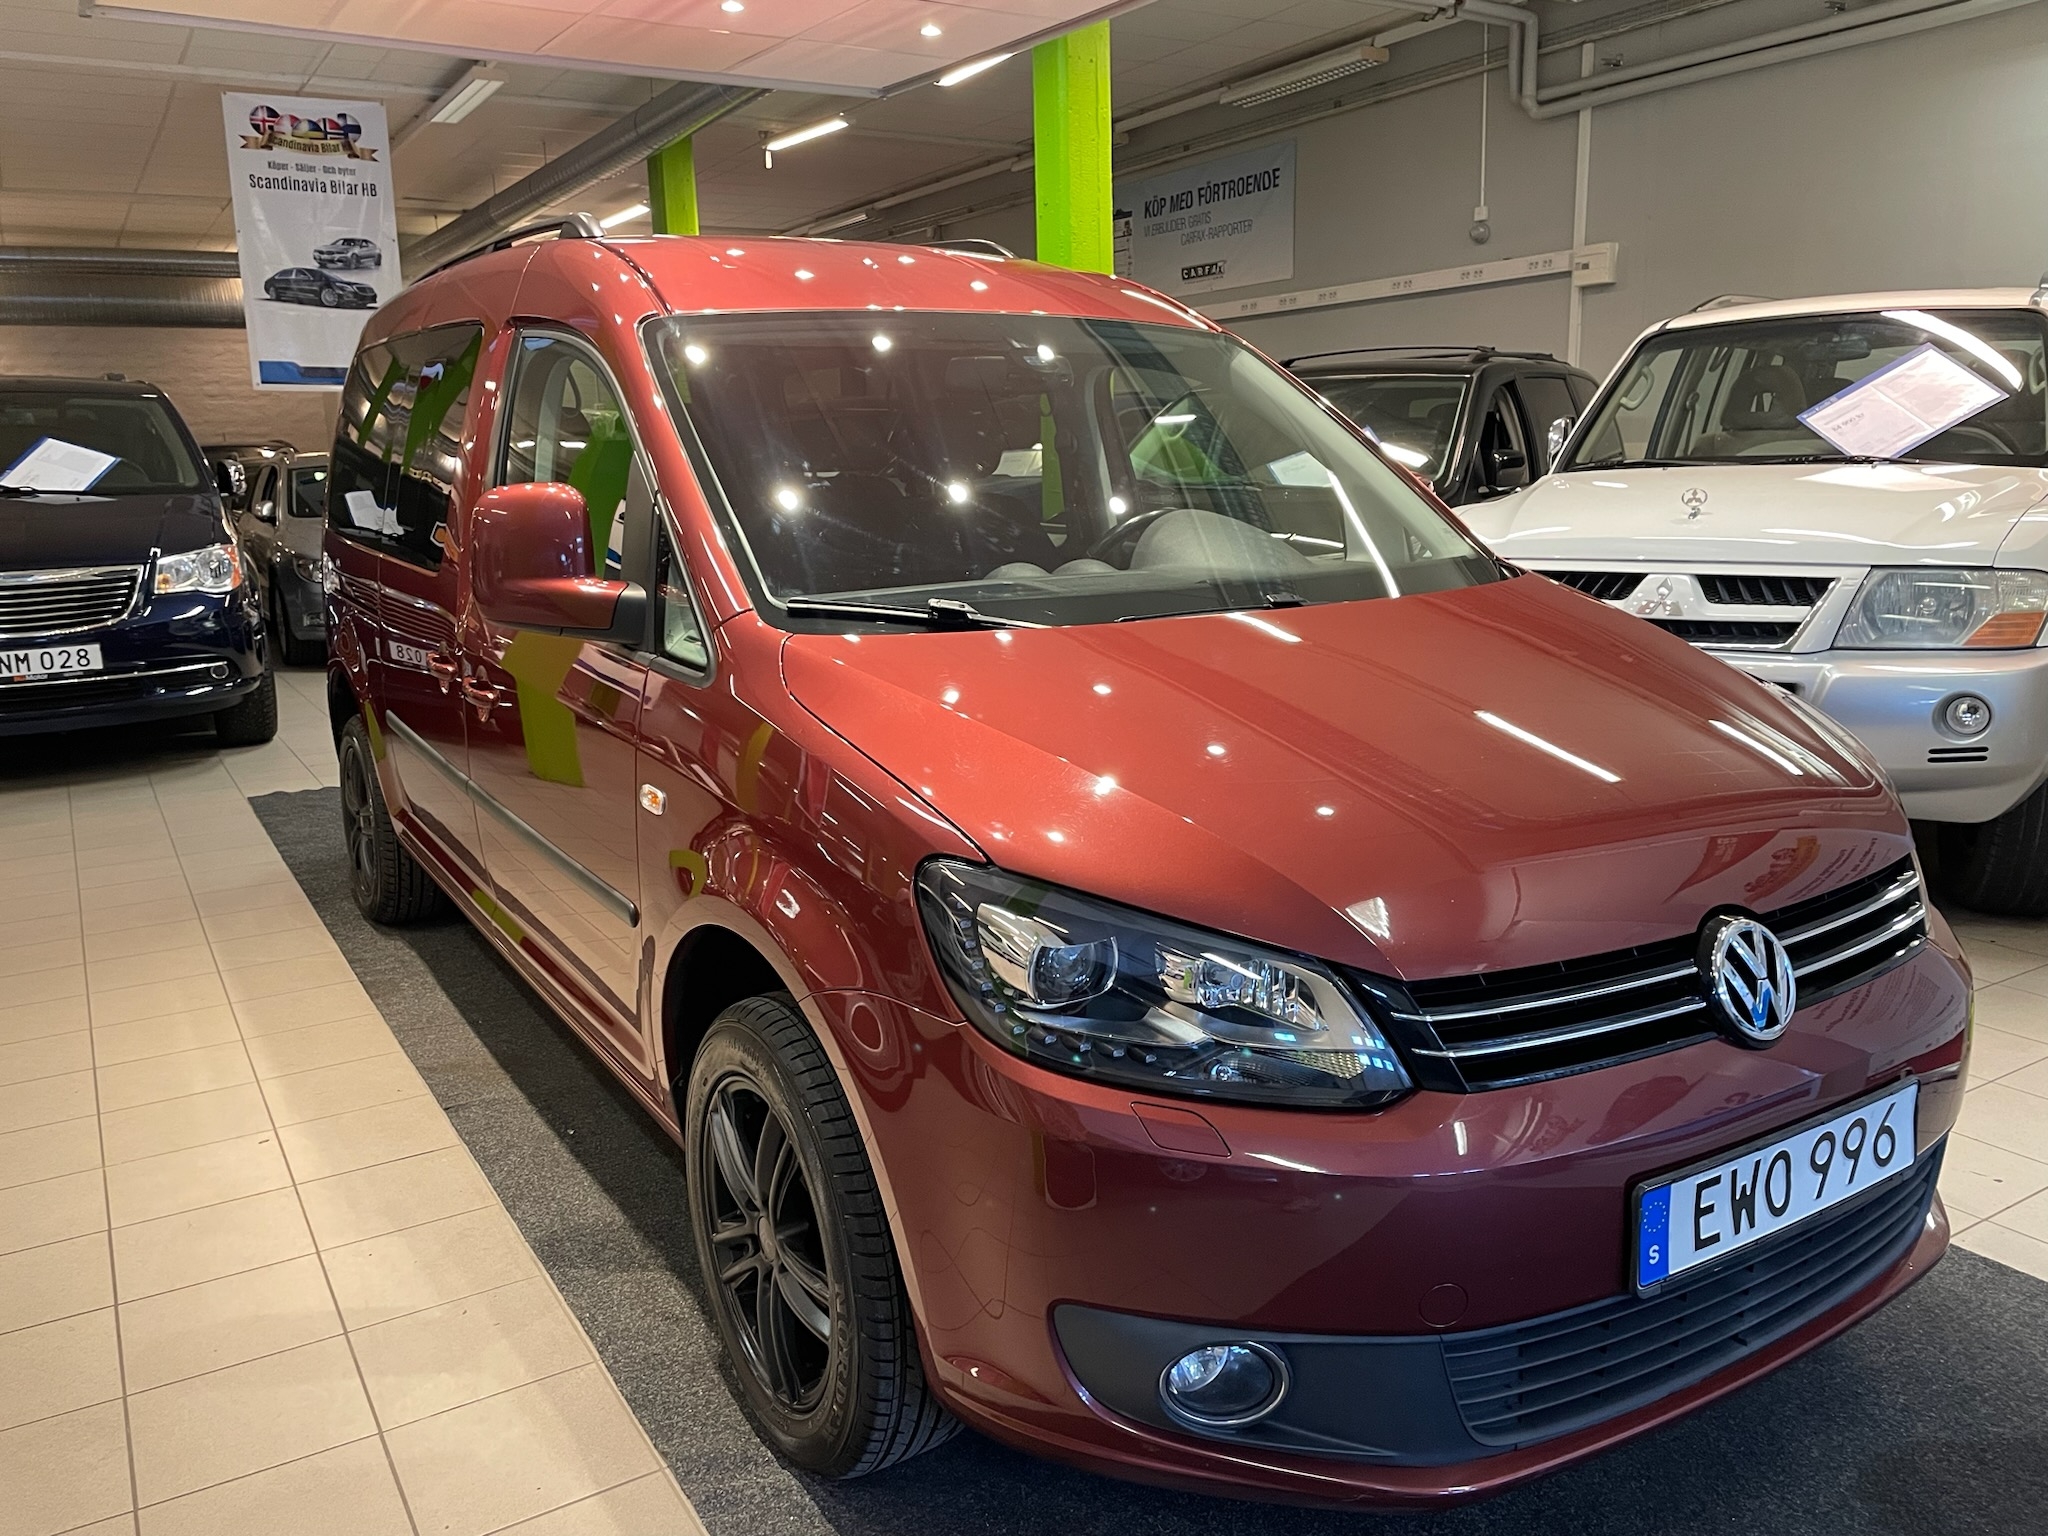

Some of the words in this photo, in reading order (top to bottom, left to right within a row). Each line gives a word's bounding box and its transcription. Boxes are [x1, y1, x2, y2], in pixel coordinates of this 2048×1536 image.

[320, 143, 341, 153] Bilar
[249, 174, 327, 194] Scandinavia
[330, 180, 359, 195] Bilar
[362, 183, 377, 197] HB
[1144, 194, 1167, 219] KÖP
[1169, 190, 1193, 213] MED
[1197, 167, 1281, 207] FÖRTROENDE
[40, 648, 90, 670] 028
[1694, 1149, 1792, 1252] EWO
[1810, 1102, 1896, 1200] 996
[1648, 1244, 1660, 1265] S
